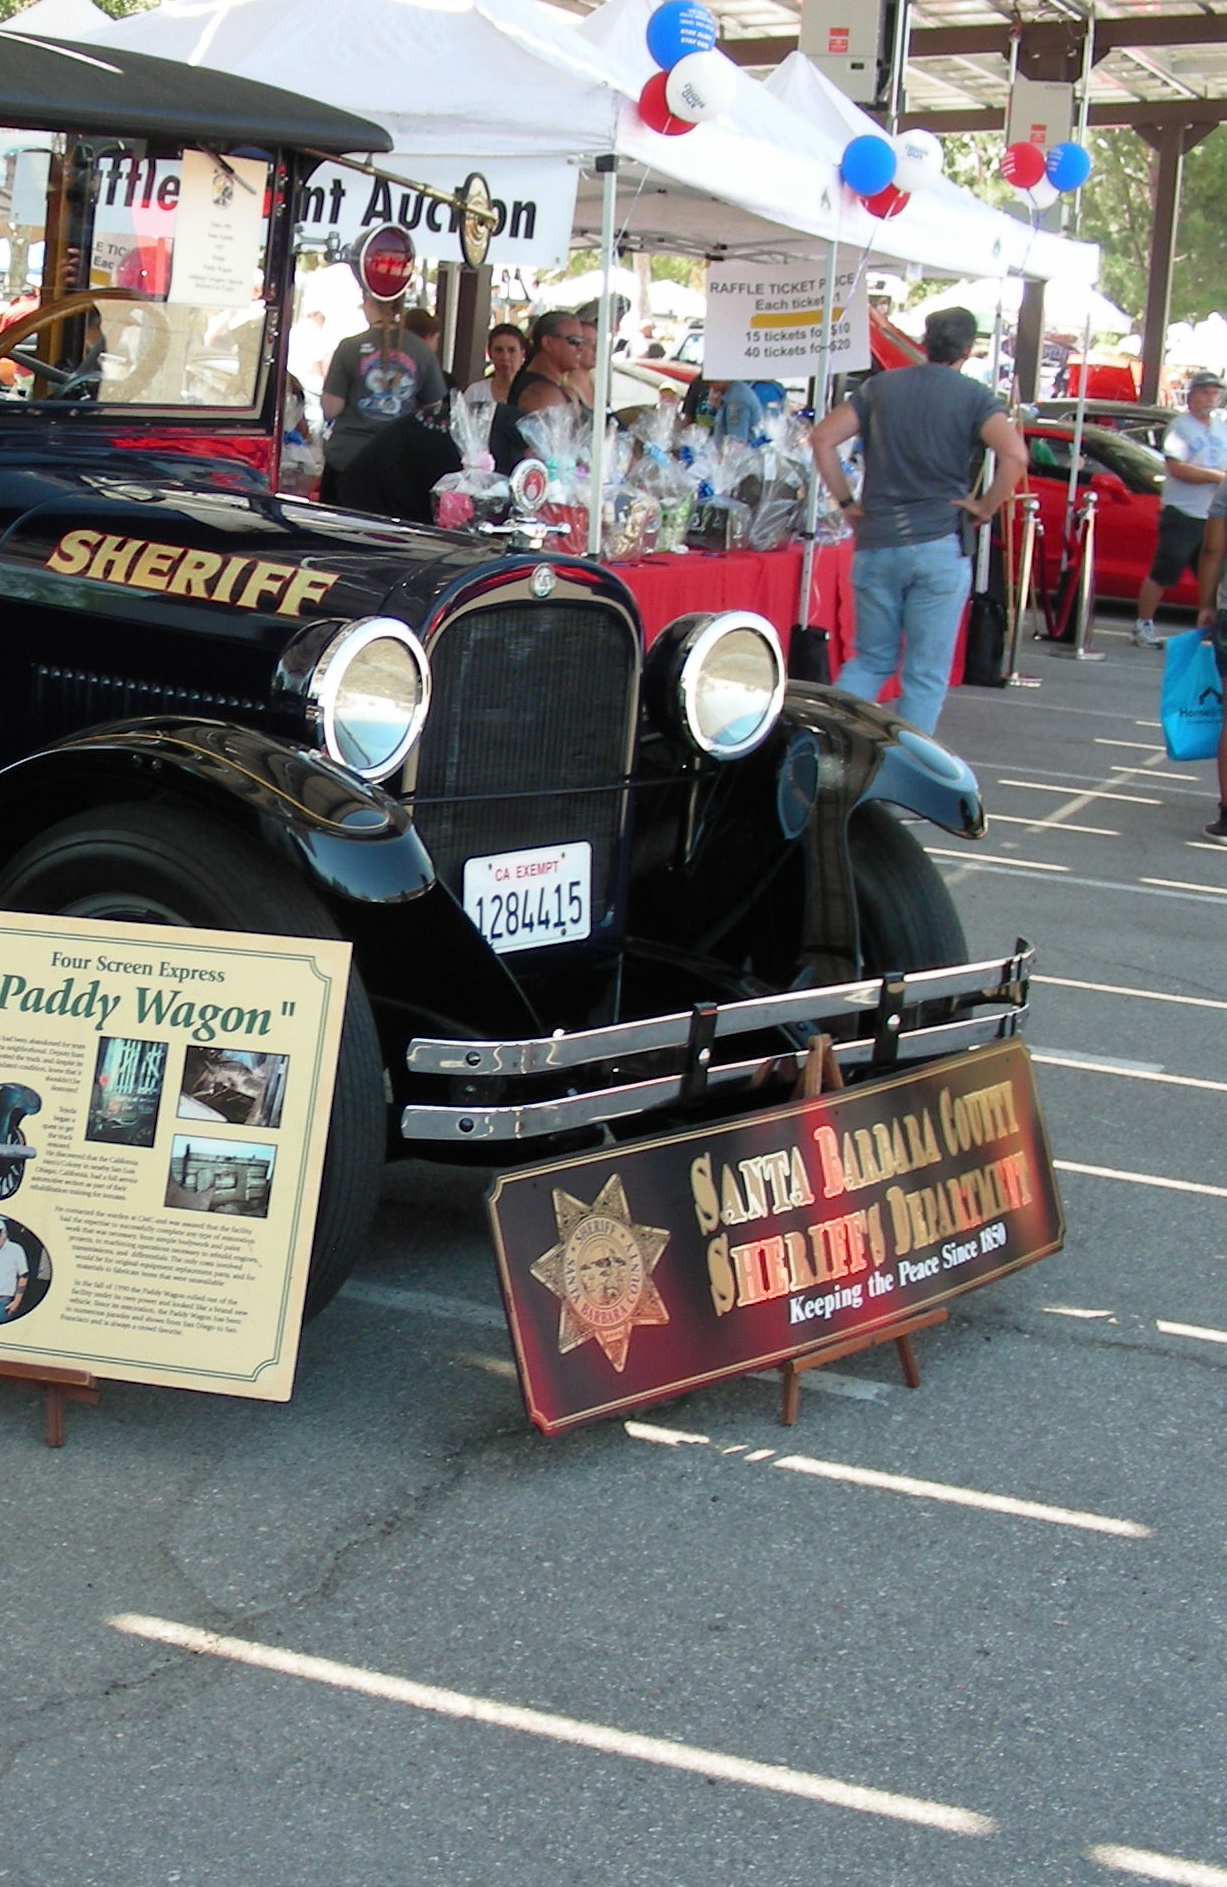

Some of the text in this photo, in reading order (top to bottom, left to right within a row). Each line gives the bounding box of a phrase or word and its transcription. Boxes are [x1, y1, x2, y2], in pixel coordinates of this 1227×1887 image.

[360, 174, 537, 239] Aucon
[709, 273, 854, 295] RAFFLE TICKET PICE
[755, 299, 788, 311] Each
[745, 322, 850, 342] 15 tickets fo $10
[744, 347, 760, 358] 40
[764, 344, 806, 357] tickets
[810, 343, 824, 354] fo
[44, 529, 341, 616] SHERIFF
[495, 860, 559, 882] CA EXEMPT
[476, 880, 582, 939] 1284415
[51, 951, 225, 984] Four Screen Express
[576, 1220, 615, 1243] SHERIFF
[789, 1222, 1007, 1324] Keeping the Peace Since 1850
[565, 1257, 580, 1304] SANTA
[580, 1304, 628, 1323] BARBARA
